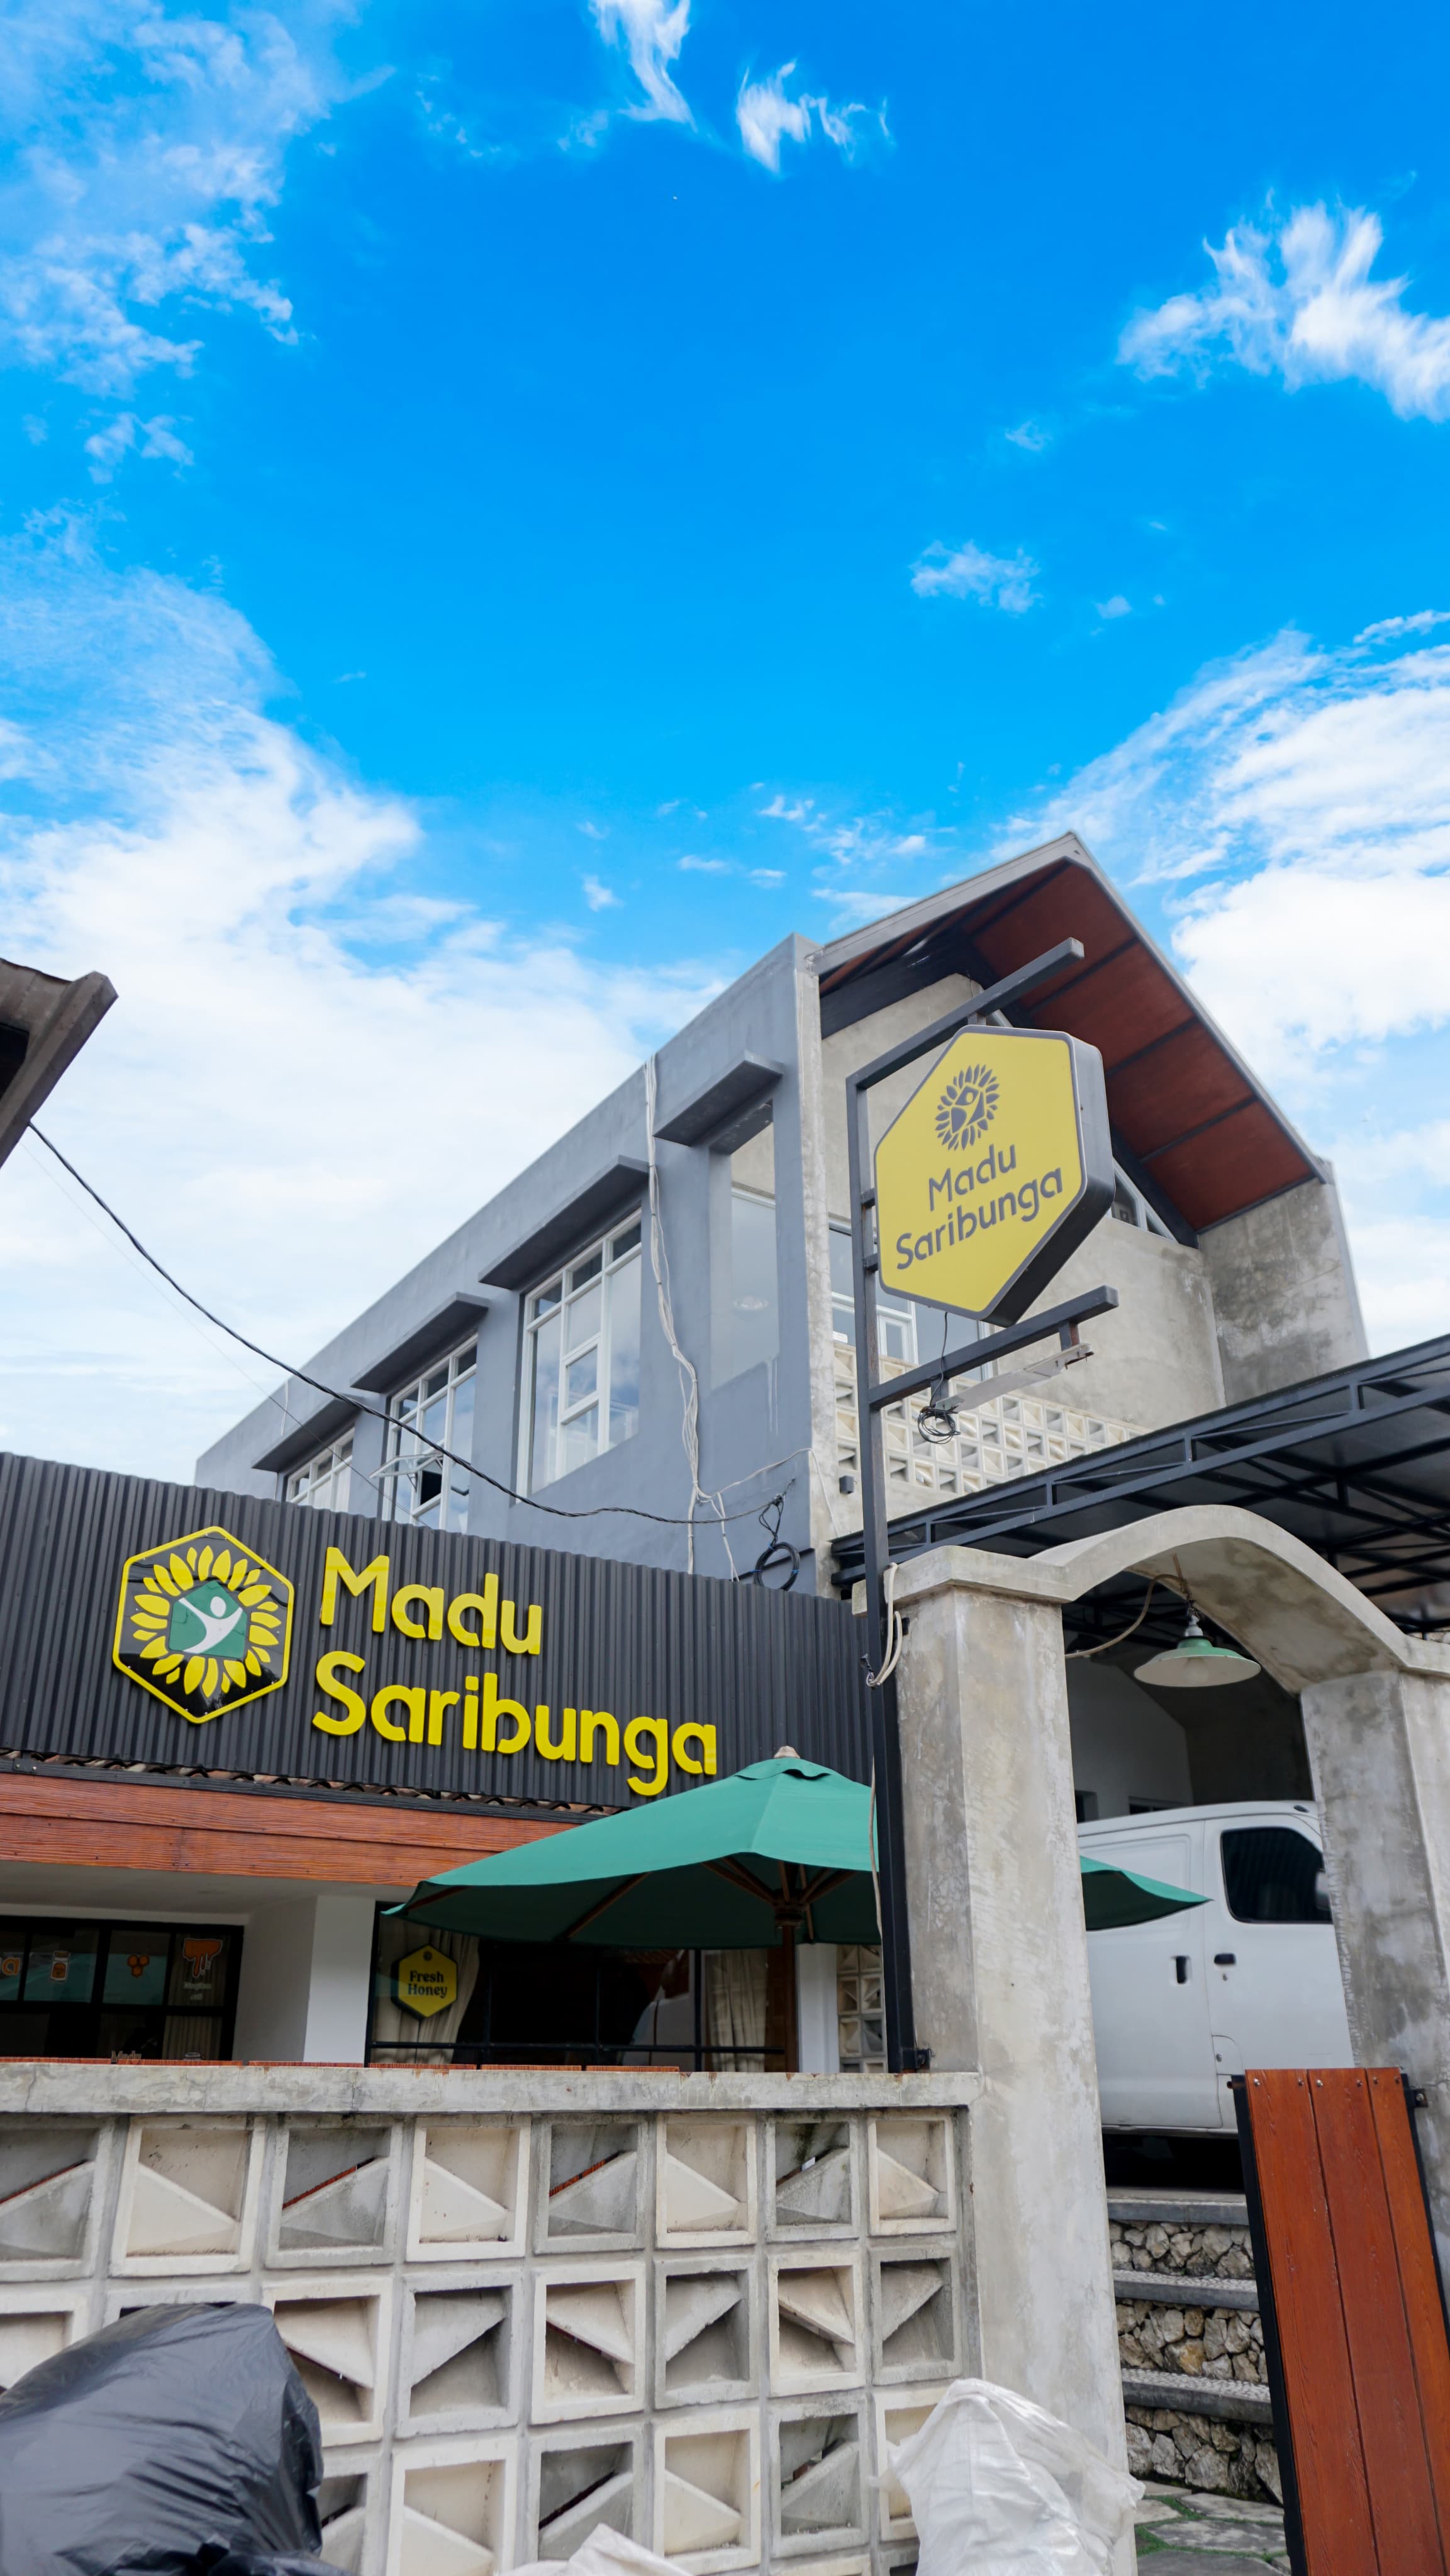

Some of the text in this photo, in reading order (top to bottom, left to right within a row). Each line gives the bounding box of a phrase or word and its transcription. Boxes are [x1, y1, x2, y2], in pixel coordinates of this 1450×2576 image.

[896, 1168, 1063, 1270] Saribunga
[929, 1144, 1017, 1211] Madu
[320, 1547, 541, 1655] Madu
[313, 1651, 717, 1796] Saribunga
[408, 1984, 447, 1999] Honey
[410, 1970, 443, 1982] Fresh
